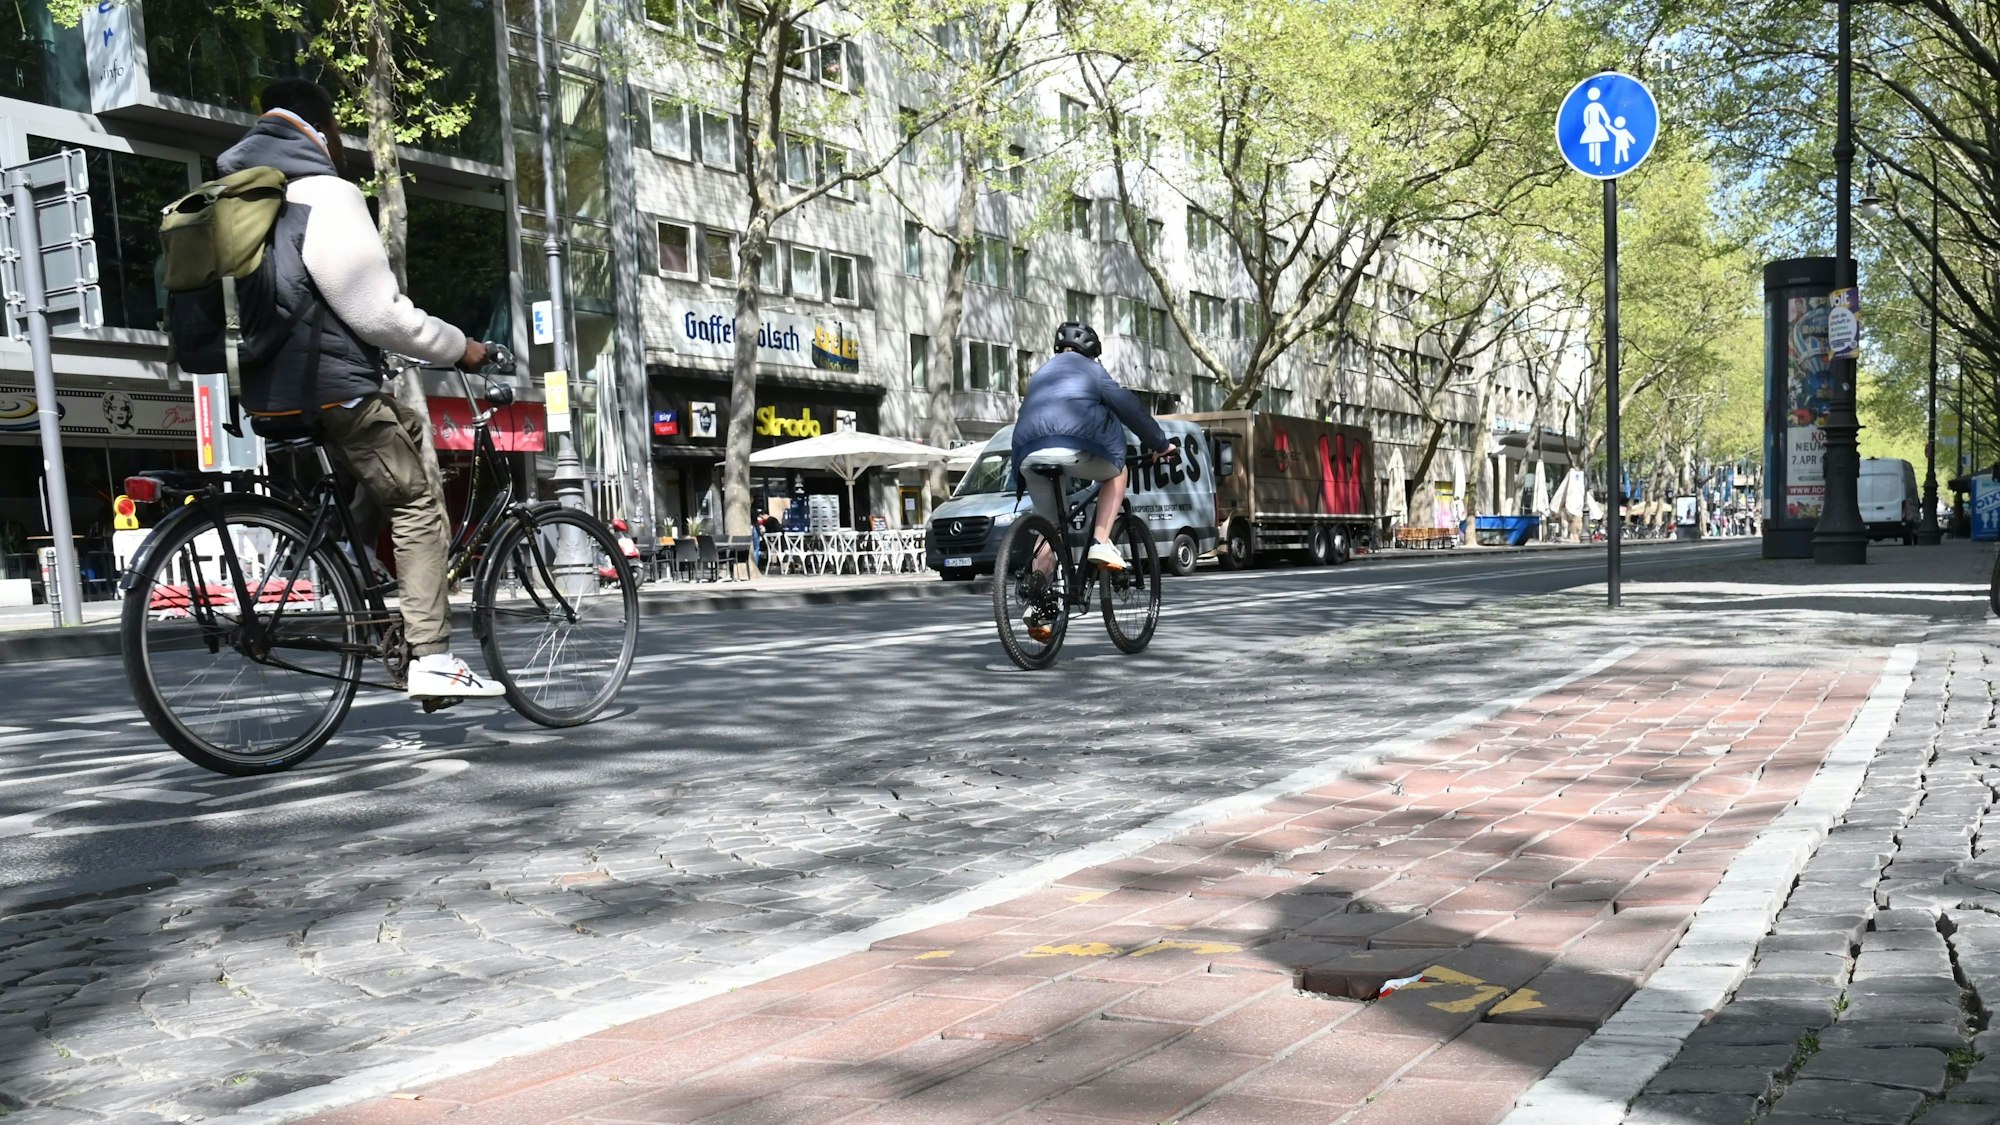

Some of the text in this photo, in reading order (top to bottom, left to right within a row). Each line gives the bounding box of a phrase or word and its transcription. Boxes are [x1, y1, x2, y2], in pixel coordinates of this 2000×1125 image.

[100, 58, 125, 83] .info
[685, 311, 800, 353] Gaffel ölsch
[658, 412, 672, 422] sky
[658, 424, 673, 433] sport
[756, 406, 821, 437] Strada
